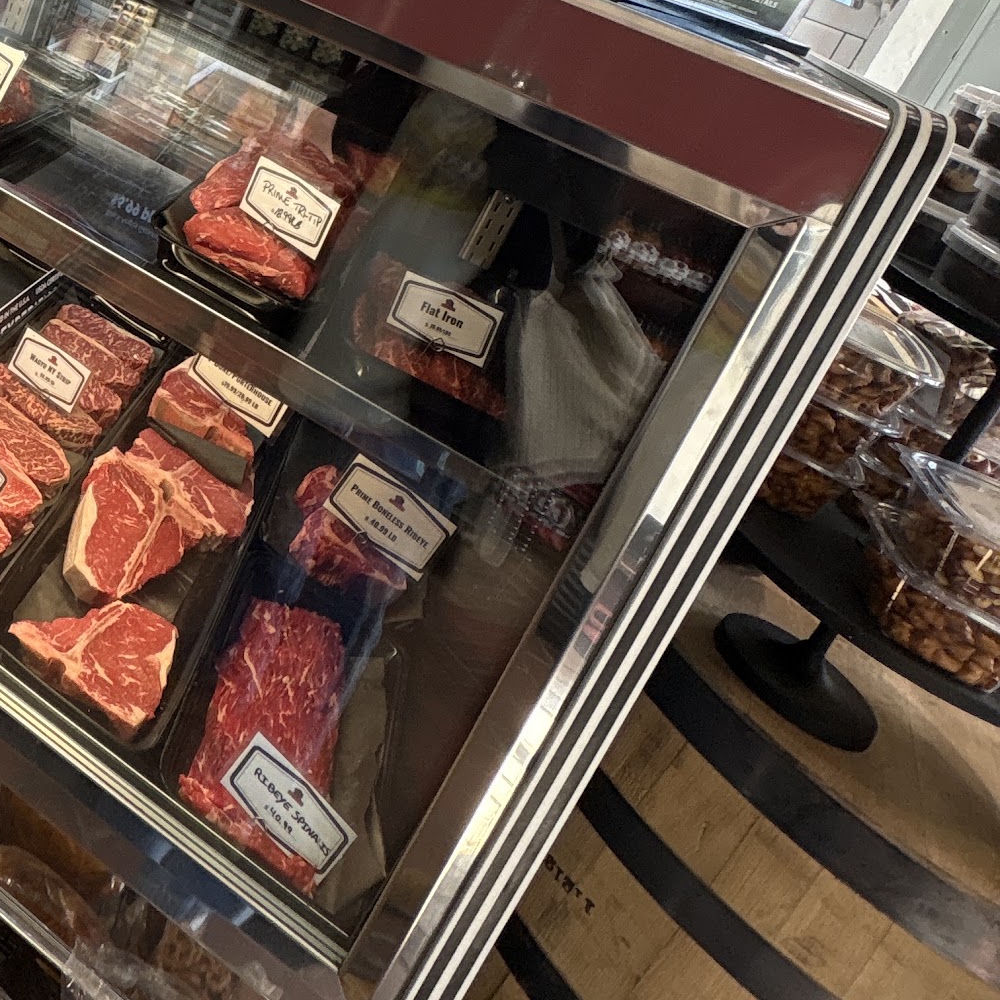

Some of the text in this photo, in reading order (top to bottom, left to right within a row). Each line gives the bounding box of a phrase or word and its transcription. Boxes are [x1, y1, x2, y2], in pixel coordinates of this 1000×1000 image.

[262, 180, 290, 207] PRIME
[293, 202, 323, 228] TRI-TIP
[420, 300, 440, 318] Flat
[442, 308, 464, 329] Iron
[254, 767, 293, 811] RIBEYE
